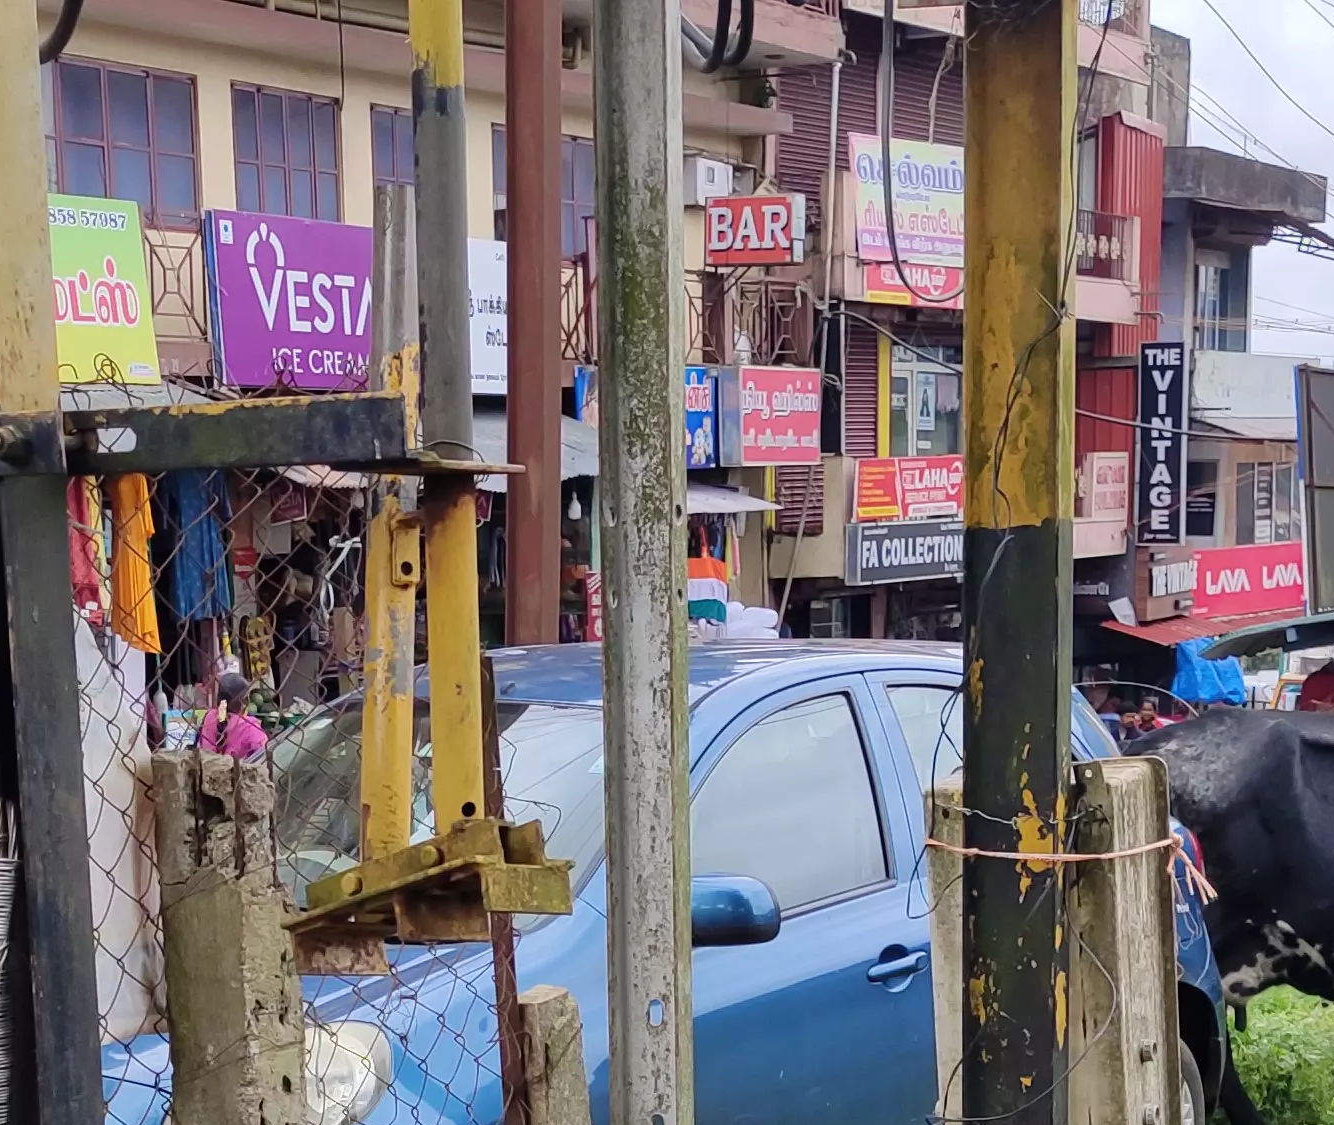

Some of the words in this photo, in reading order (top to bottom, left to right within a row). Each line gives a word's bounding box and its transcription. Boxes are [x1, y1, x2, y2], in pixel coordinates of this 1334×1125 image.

[708, 204, 791, 250] BAR
[272, 347, 303, 375] ICE
[1144, 348, 1182, 366] THE
[1150, 370, 1174, 531] VINTAGE
[862, 540, 879, 568] FA
[882, 535, 963, 567] COLLECTION
[1205, 568, 1251, 596] LAVA
[1262, 562, 1302, 590] LAVA
